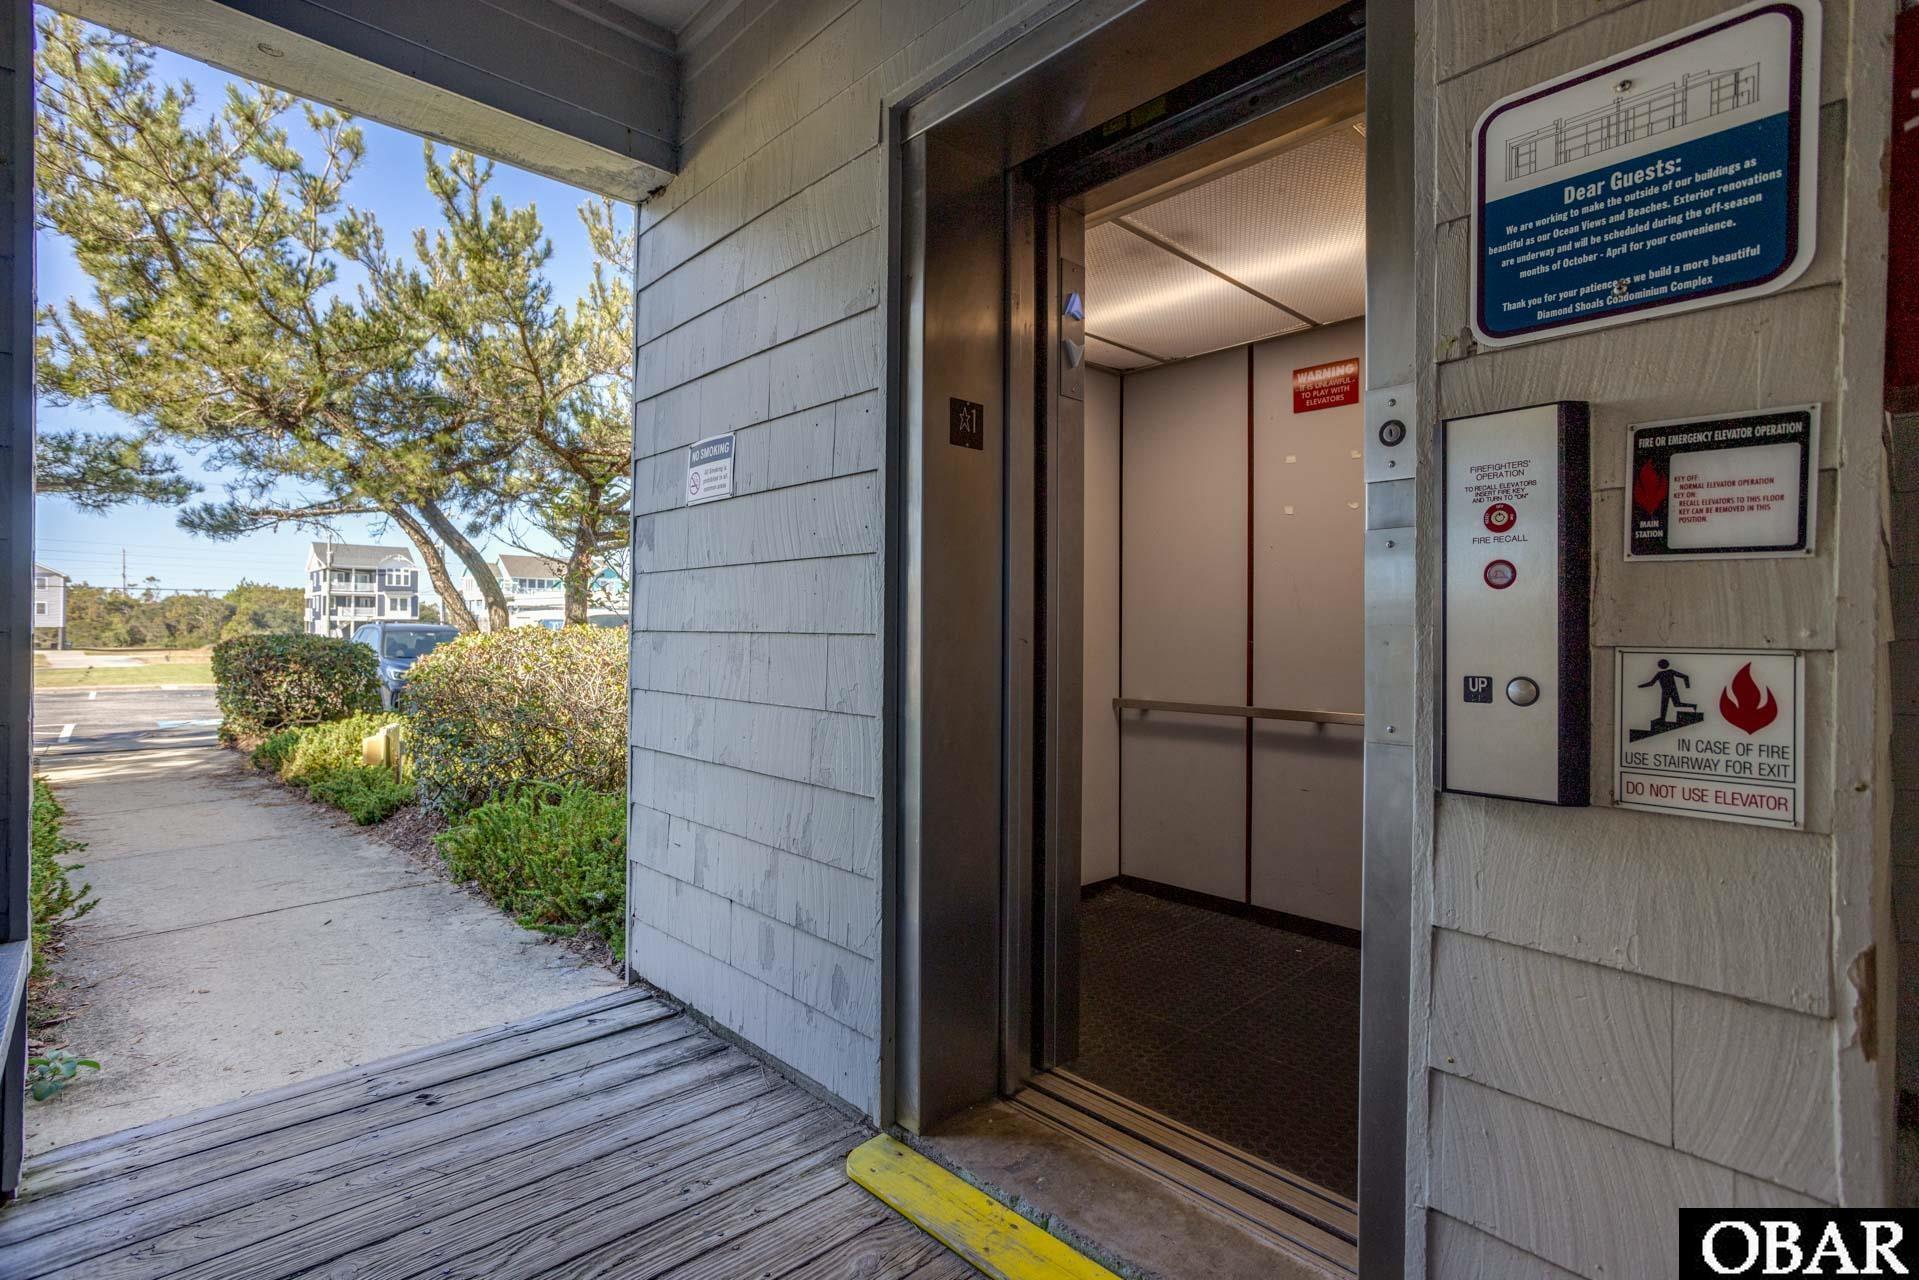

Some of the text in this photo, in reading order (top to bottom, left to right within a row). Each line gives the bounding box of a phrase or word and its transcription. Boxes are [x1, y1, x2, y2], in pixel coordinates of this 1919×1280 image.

[1564, 158, 1682, 204] Dear Guests:
[1506, 158, 1757, 235] We are working to make the outside of our buildings as
[1488, 169, 1783, 255] beautiful as our Ocean Views and Beaches. Exterior renovations
[1501, 193, 1763, 267] are underway and will be scheduled during the off-season
[1520, 263, 1550, 278] months
[1551, 260, 1562, 271] of
[1563, 253, 1598, 268] October
[1606, 244, 1627, 259] April
[1630, 240, 1645, 252] for
[1646, 235, 1668, 250] your
[1670, 218, 1737, 242] convenience.
[1502, 298, 1526, 312] Thank
[1527, 295, 1542, 308] you
[1544, 292, 1557, 303] for
[1558, 287, 1578, 301] your
[1580, 278, 1617, 296] patience
[1633, 273, 1646, 282] we
[1648, 265, 1672, 280] build
[1674, 265, 1680, 274] a
[1683, 259, 1710, 271] more
[1712, 244, 1761, 265] beautiful
[1537, 304, 1573, 320] Diamond
[1575, 298, 1604, 312] Shoals
[1670, 275, 1713, 292] Complex
[1297, 364, 1354, 383] WARNING
[1301, 385, 1350, 399] TO PLAY WITH
[1306, 394, 1345, 407] ELEVATORS
[1639, 421, 1803, 449] FIRE OR EMERGENCY ELEVATOR OPERATION
[692, 442, 730, 462] NO SMOKING
[1470, 460, 1531, 474] FIREFIGHTERS'
[1476, 469, 1525, 481] OPERATION
[1475, 483, 1497, 492] RECALL
[1500, 480, 1537, 489] ELEVATORS
[1680, 477, 1774, 490] NORMAL ELEVATOR OPERATION
[1475, 490, 1497, 498] INSERT
[1487, 495, 1502, 503] TURN
[1679, 498, 1700, 507] RECALL
[1701, 496, 1735, 506] ELEVATORS
[1747, 495, 1761, 503] THIS
[1763, 494, 1785, 502] FLOOR
[1691, 507, 1704, 515] CAN
[1715, 506, 1745, 514] REMOVED
[1640, 520, 1659, 528] MAIN
[1472, 534, 1528, 545] FIRE RECALL
[1635, 530, 1663, 538] STATION
[1469, 677, 1487, 692] UP
[1677, 738, 1790, 760] IN CASE OF FIRE
[1625, 752, 1790, 778] USE STAIRWAY FOR EXIT
[1626, 781, 1789, 812] DO NOT USE ELEVATOR
